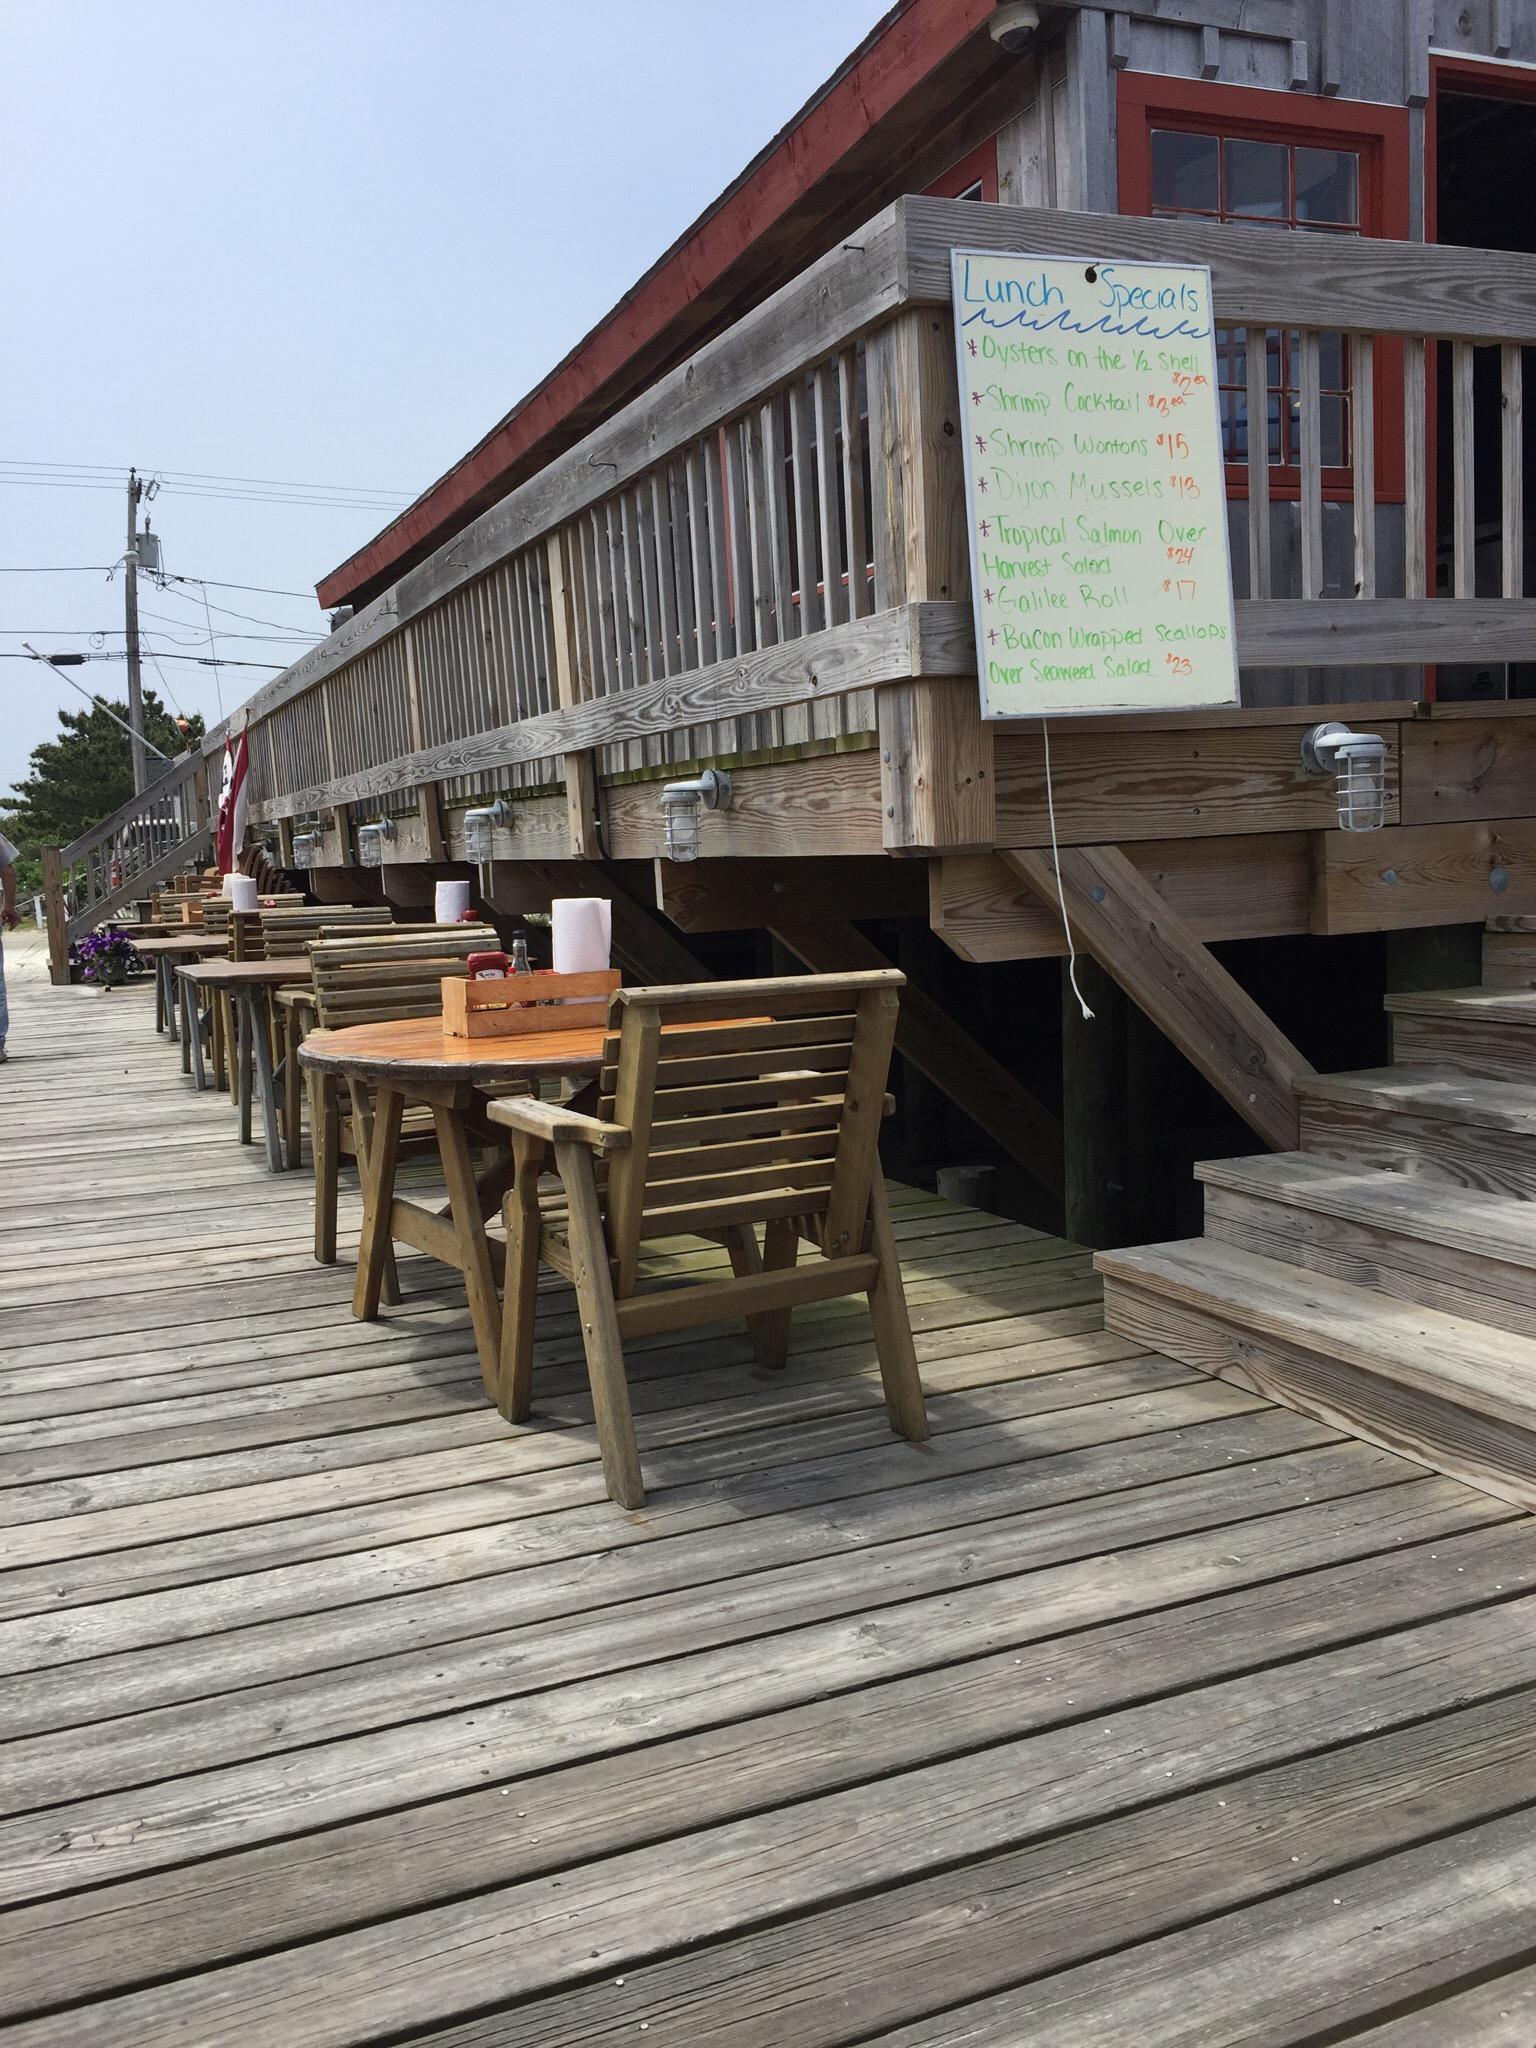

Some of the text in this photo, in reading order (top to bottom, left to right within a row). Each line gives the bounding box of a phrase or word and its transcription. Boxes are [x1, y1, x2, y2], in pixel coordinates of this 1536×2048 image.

[964, 260, 1199, 318] Lunch Specials
[982, 335, 1058, 369] Oysters
[1067, 350, 1088, 370] on
[1095, 346, 1126, 371] the
[985, 384, 1051, 416] Shrimp
[1064, 382, 1140, 412] Cocktail
[990, 428, 1190, 462] Shrimp Wontons $15
[990, 466, 1201, 509] Dijon Mussels $13
[988, 515, 1208, 551] Tropical Salmon Over
[984, 547, 1194, 580] Harvest Salad $24
[997, 578, 1196, 614] Galilee Roll $17
[1000, 623, 1227, 651] Bacon Wrapped Scallops
[990, 653, 1193, 686] Over Seaweed Salad $23
